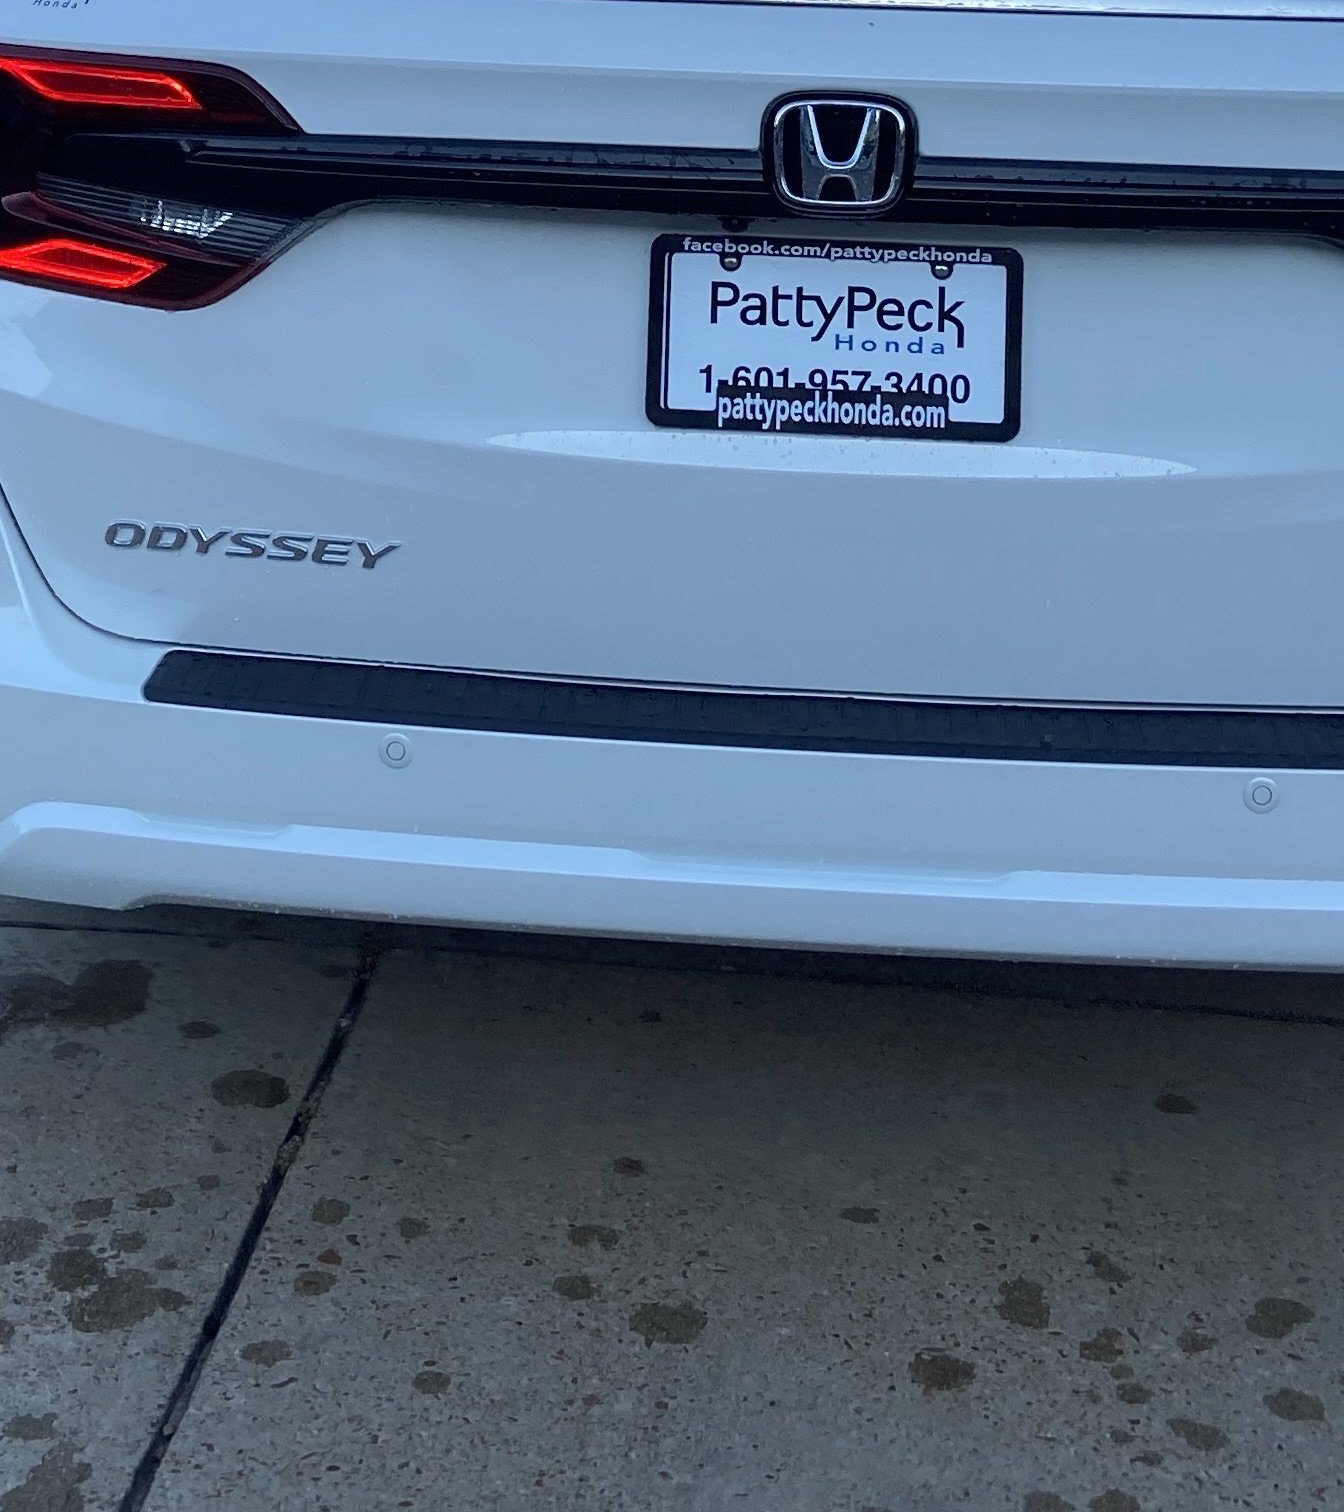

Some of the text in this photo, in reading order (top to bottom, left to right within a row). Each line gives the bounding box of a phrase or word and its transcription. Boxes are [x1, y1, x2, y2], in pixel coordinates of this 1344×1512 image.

[682, 236, 993, 264] facebook.com/pattypeckhonda
[709, 280, 966, 348] PattyPeck
[834, 333, 946, 355] Honda
[717, 390, 946, 430] pattypeckhonda.com
[104, 519, 402, 569] ODYSSEY
